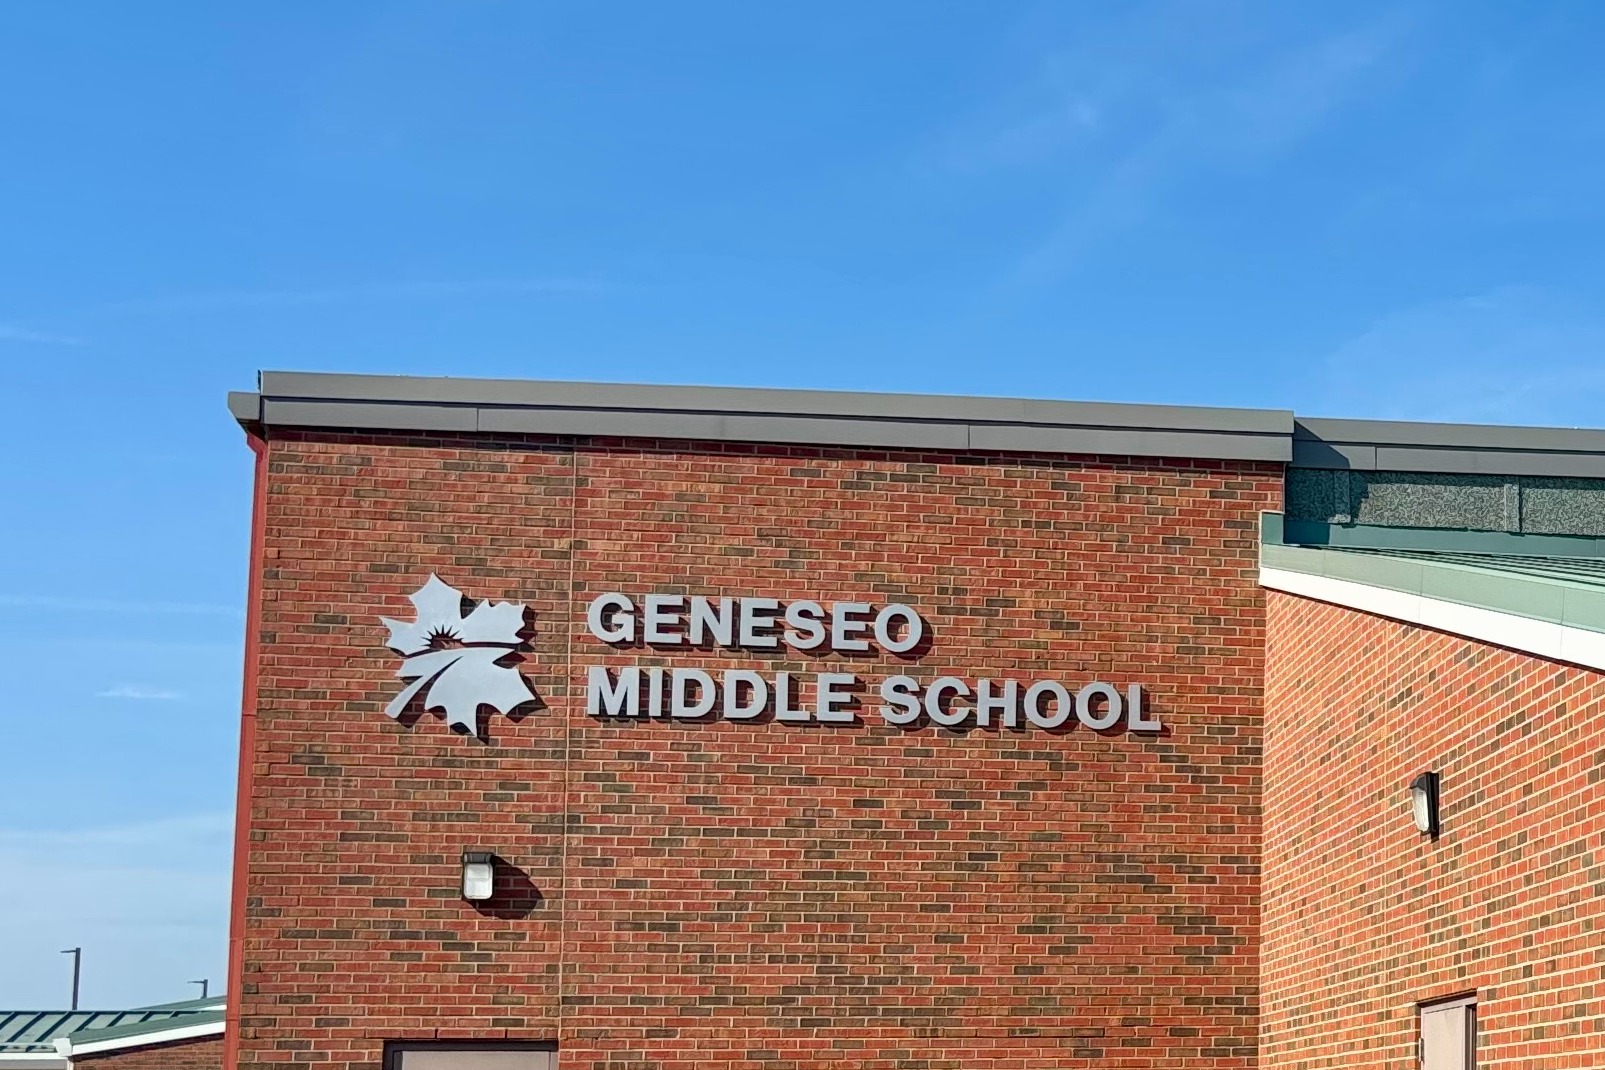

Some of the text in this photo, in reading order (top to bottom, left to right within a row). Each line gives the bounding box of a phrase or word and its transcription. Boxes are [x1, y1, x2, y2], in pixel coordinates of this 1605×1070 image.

[587, 593, 924, 655] GENESEO
[587, 666, 1162, 731] MIDDLE SCHOOL
